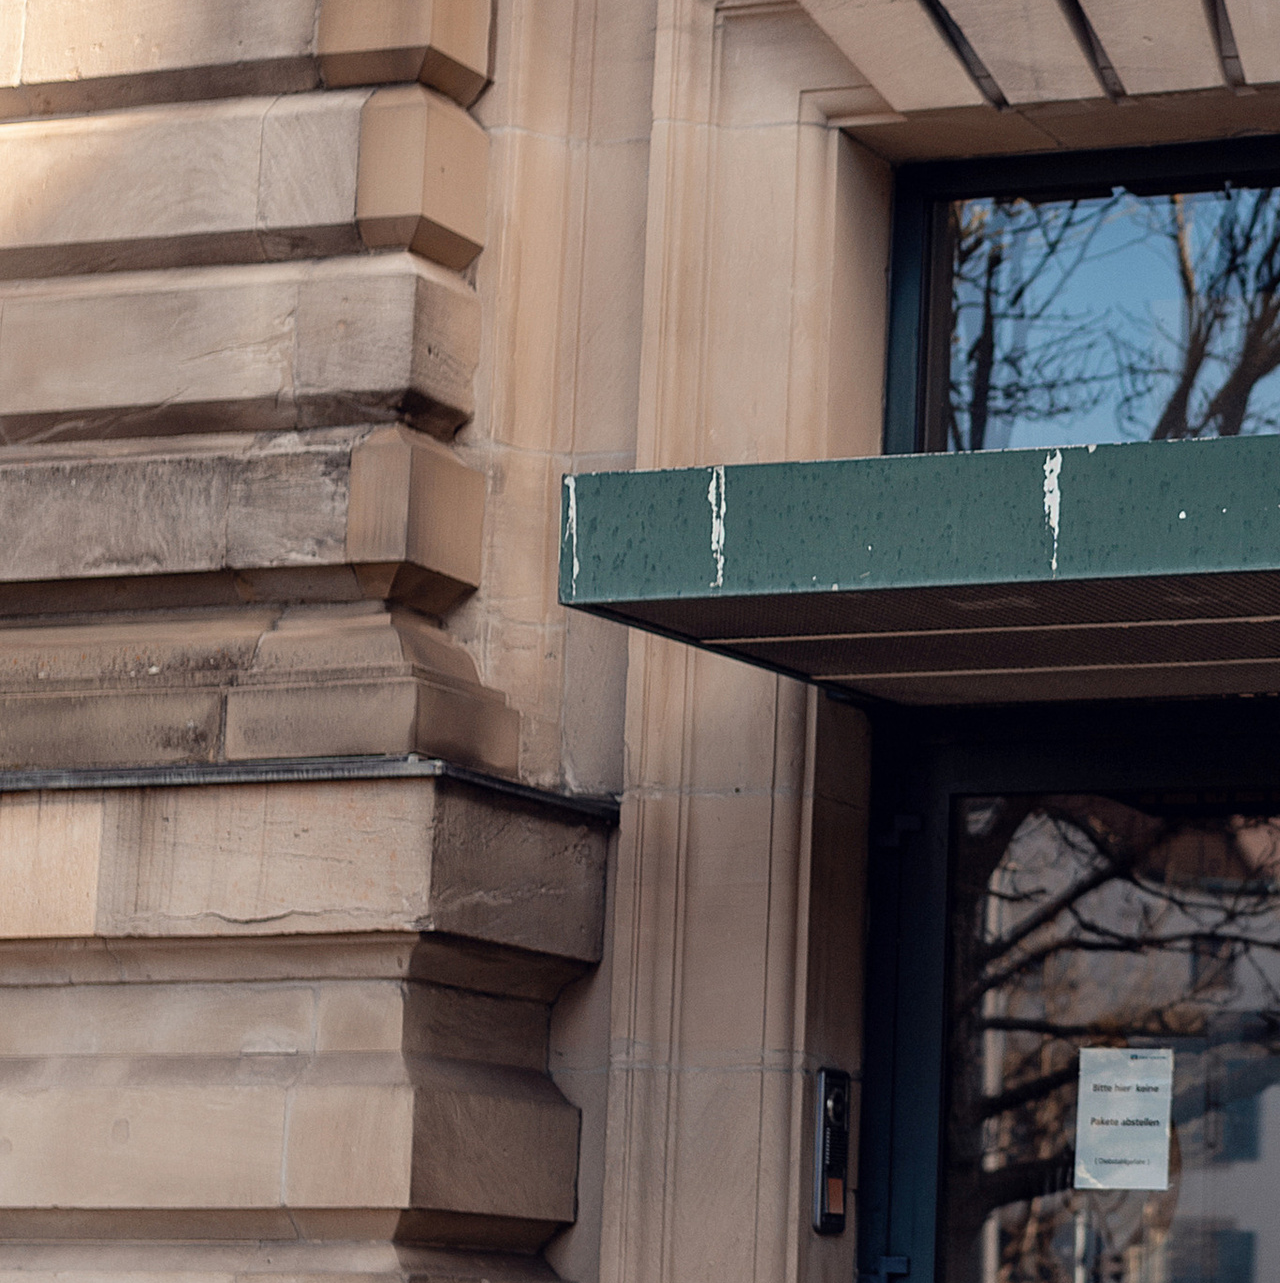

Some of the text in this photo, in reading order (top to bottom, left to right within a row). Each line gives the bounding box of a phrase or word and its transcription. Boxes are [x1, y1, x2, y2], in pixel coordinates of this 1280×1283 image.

[1092, 1083, 1159, 1093] Bitte hier keine
[1090, 1117, 1160, 1127] Pakete abstellen
